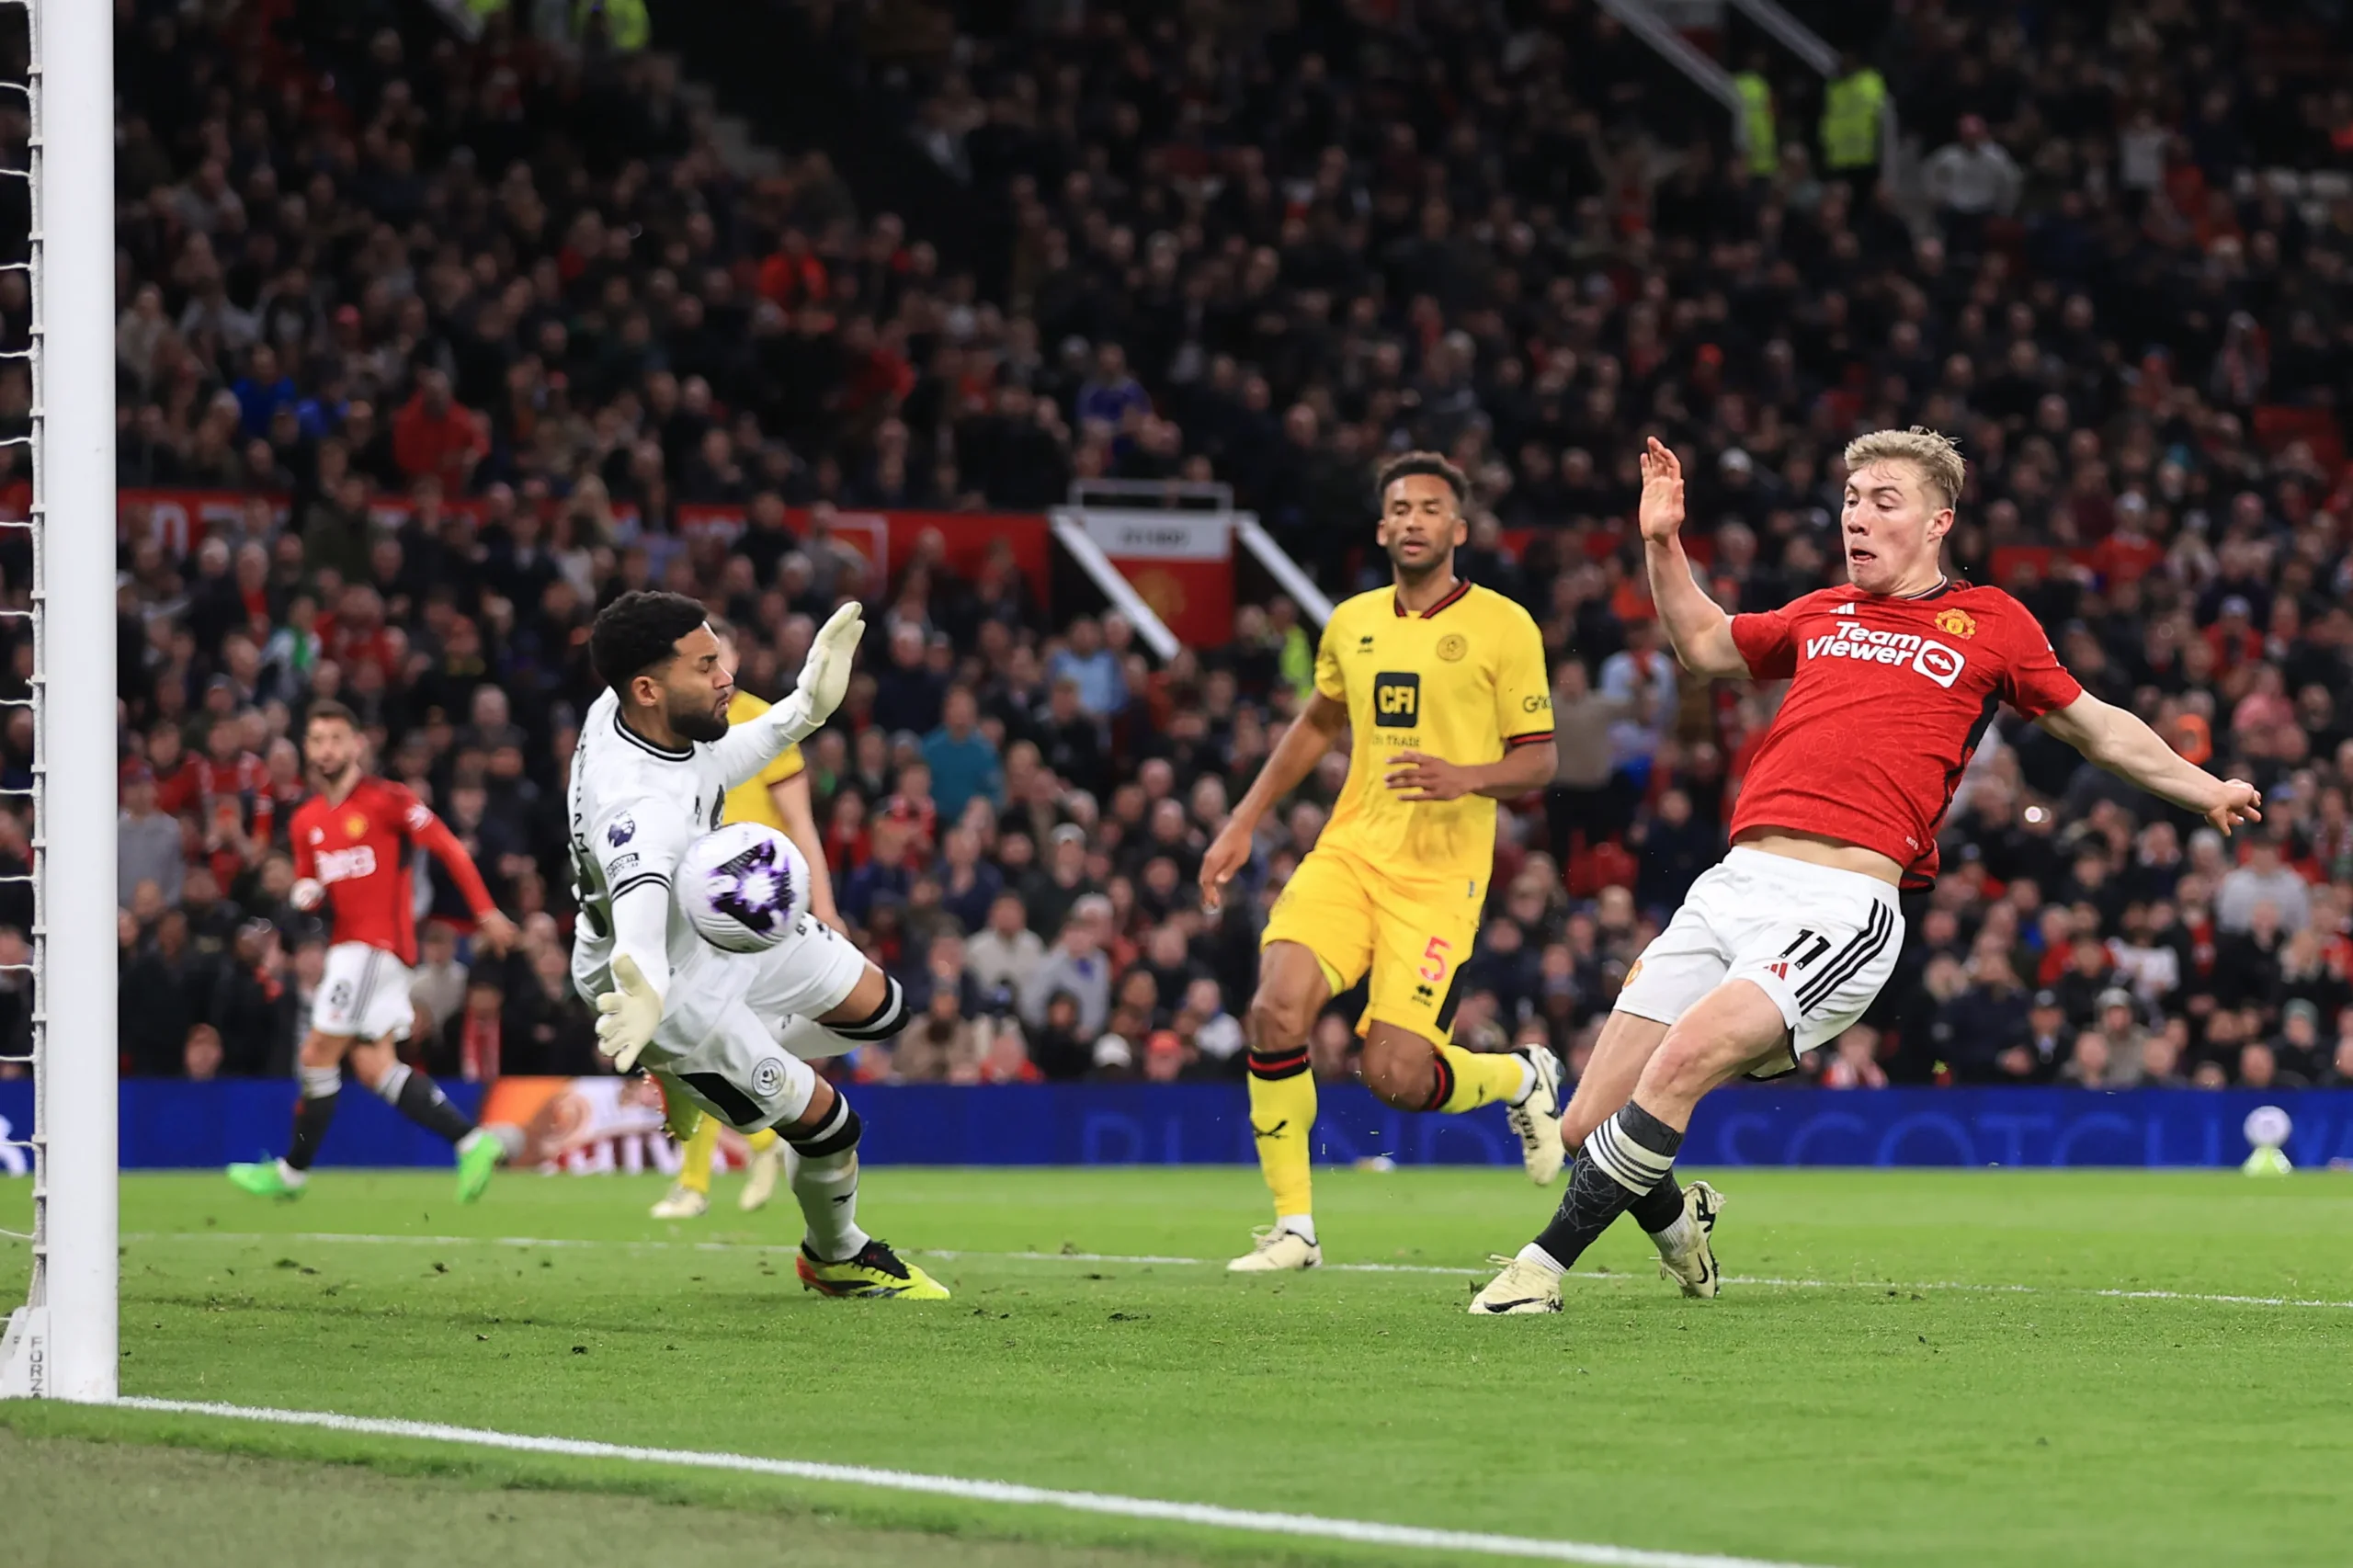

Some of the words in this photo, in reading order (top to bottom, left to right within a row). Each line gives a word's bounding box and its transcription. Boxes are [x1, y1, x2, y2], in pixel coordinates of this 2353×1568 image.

[1806, 635, 1914, 666] Viewer
[1836, 621, 1921, 651] Team
[1378, 684, 1415, 715] CFI
[1420, 936, 1451, 982] 5
[1778, 928, 1832, 971] 11
